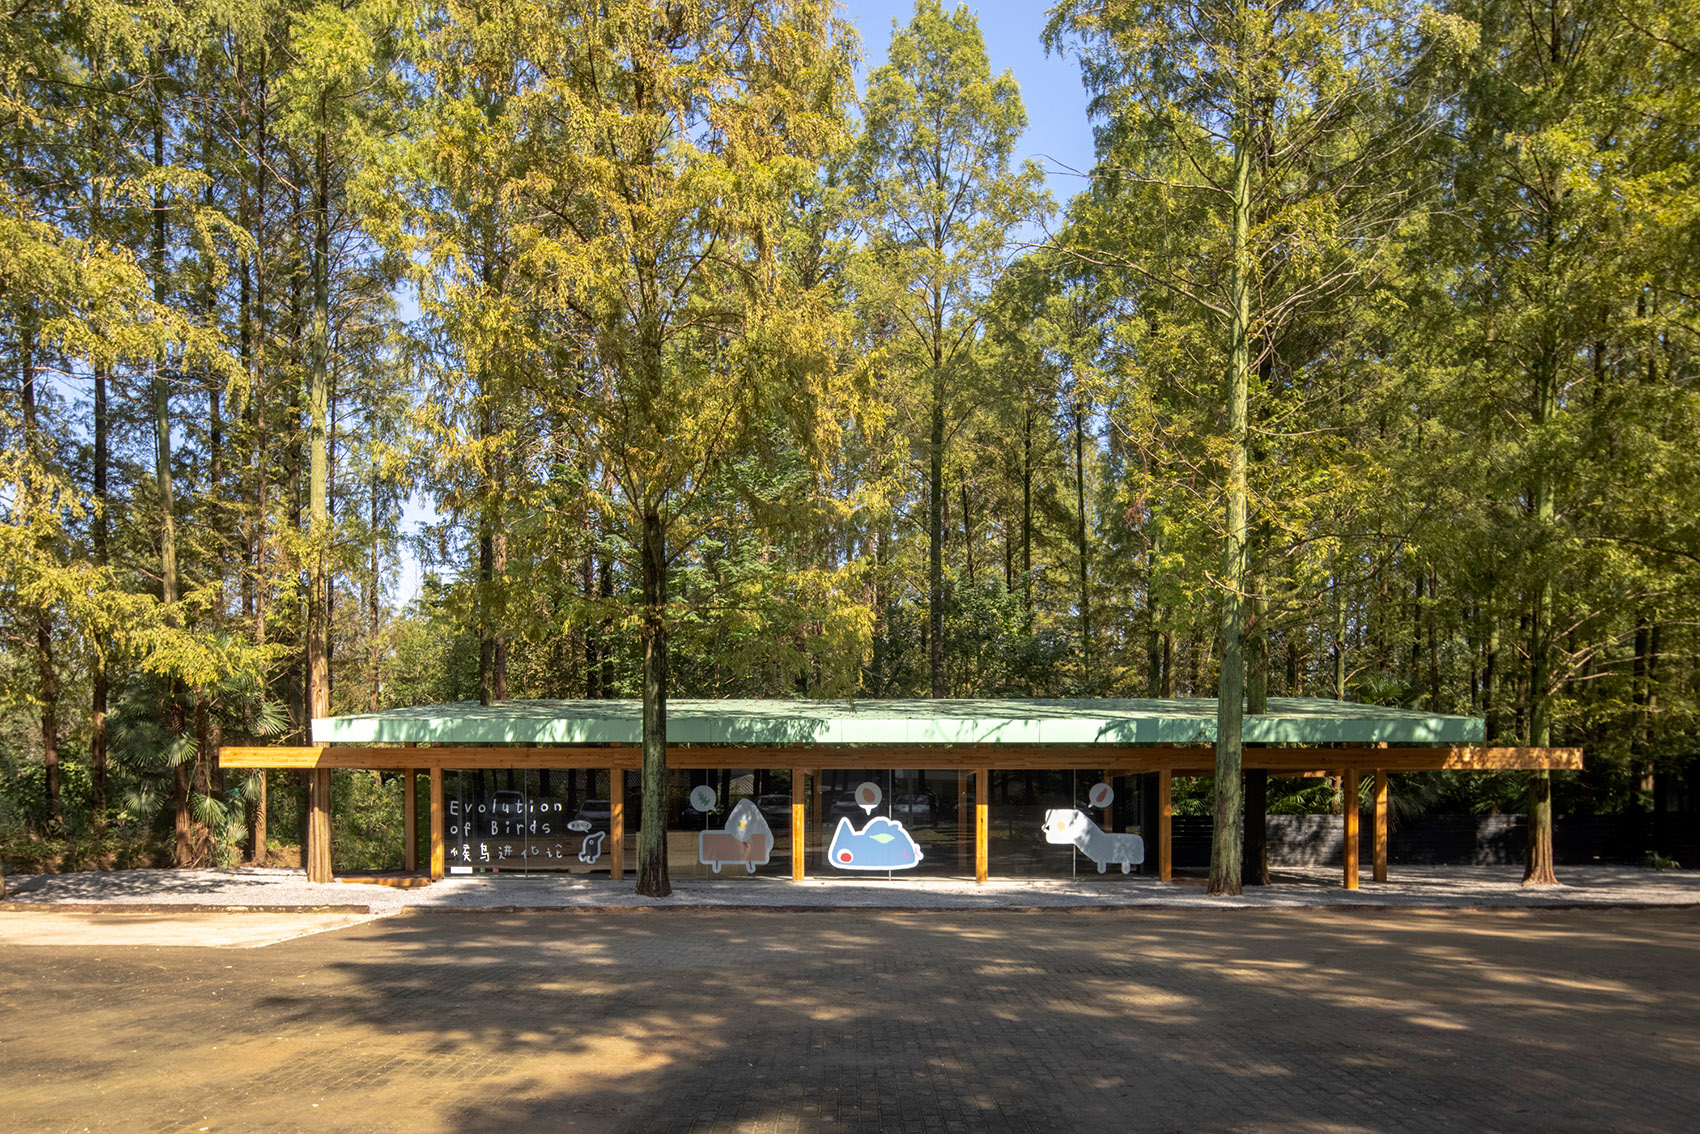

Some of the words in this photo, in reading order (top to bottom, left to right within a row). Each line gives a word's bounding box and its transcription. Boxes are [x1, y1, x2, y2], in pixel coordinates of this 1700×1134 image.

[450, 799, 562, 815] Evolution
[450, 821, 471, 836] of
[491, 820, 551, 835] Birds
[450, 843, 563, 862] 候鸟进化论
